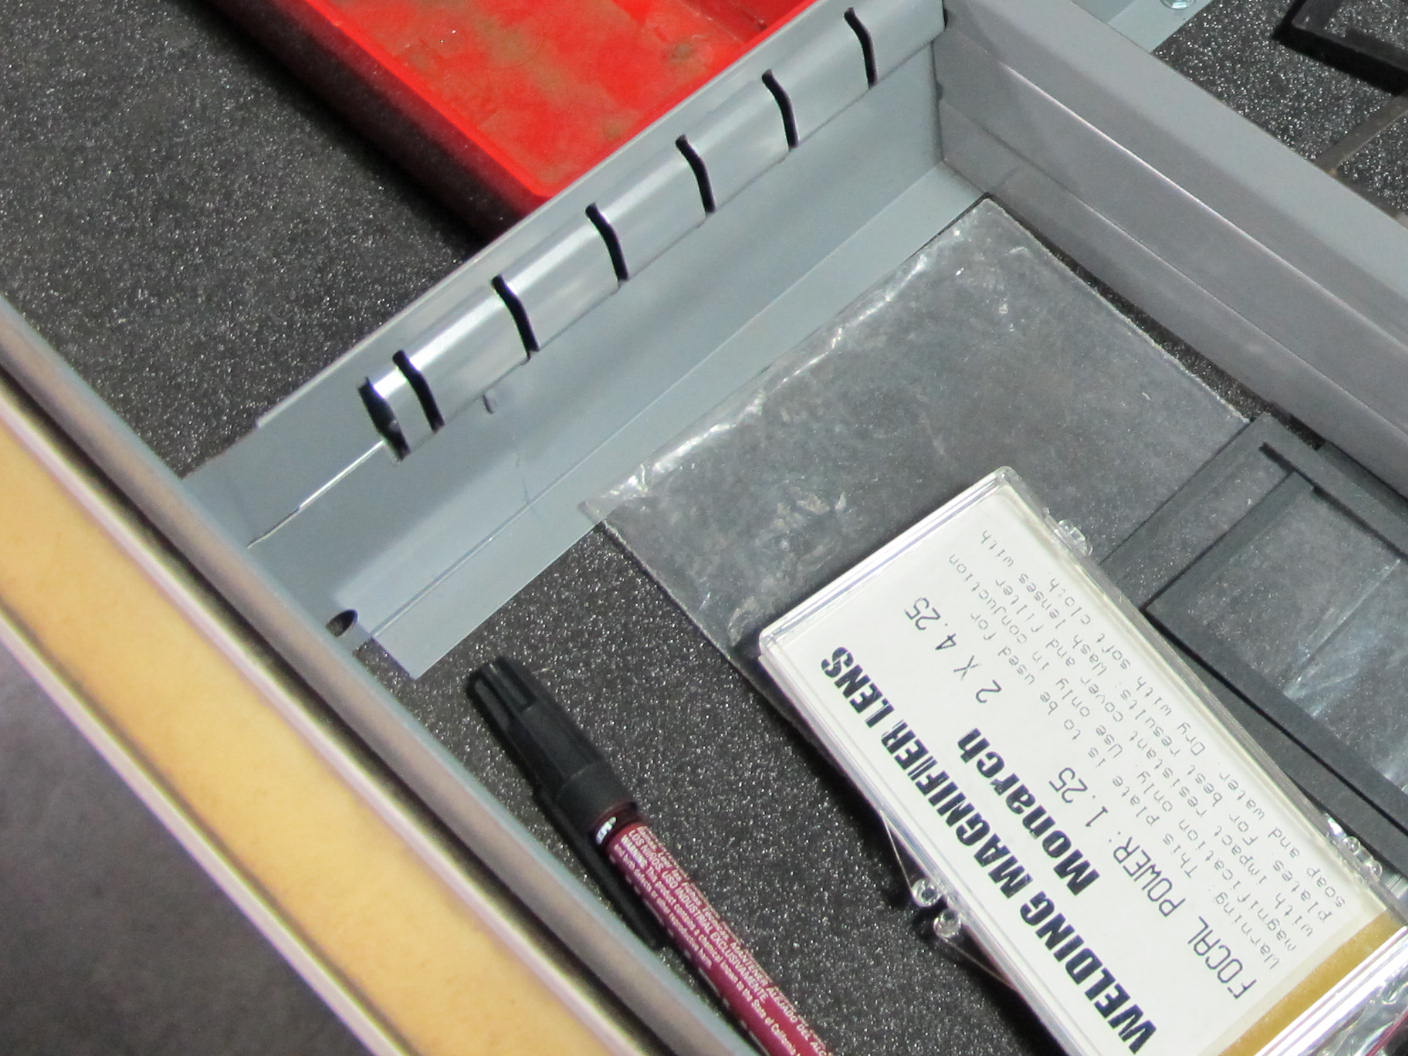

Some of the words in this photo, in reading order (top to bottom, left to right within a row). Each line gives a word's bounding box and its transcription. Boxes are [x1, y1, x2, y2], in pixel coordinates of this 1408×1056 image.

[978, 529, 1015, 568] with
[946, 553, 1028, 644] conjuction
[993, 578, 1044, 633] filter
[1017, 572, 1067, 629] lenses
[903, 597, 958, 653] 4.25
[968, 611, 997, 641] for
[952, 654, 979, 679] X
[996, 645, 1036, 686] used
[1029, 649, 1050, 672] in
[1044, 637, 1076, 668] and
[1070, 633, 1108, 676] Wash
[1094, 632, 1132, 671] soft
[819, 646, 894, 728] LENS
[974, 679, 1002, 705] 2
[1037, 690, 1059, 715] be
[1053, 677, 1092, 719] only
[1079, 676, 1125, 723] cover
[1134, 675, 1173, 717] with
[1061, 718, 1082, 741] to
[1093, 724, 1124, 759] Use
[1175, 721, 1207, 756] Dry
[1085, 746, 1106, 768] is
[1127, 731, 1207, 817] resistant
[1048, 766, 1109, 828] 1.25
[1110, 775, 1160, 827] plate
[1185, 764, 1223, 807] best
[881, 723, 1031, 897] MAGNIFIER
[956, 729, 1098, 894] Monarch
[1227, 813, 1259, 846] For
[1160, 832, 1199, 878] This
[1212, 825, 1268, 885] impact
[1266, 826, 1301, 860] and
[1108, 833, 1185, 917] POWER:
[1176, 818, 1297, 952] magnification
[1305, 866, 1347, 909] soap
[1272, 892, 1314, 938] with
[1019, 892, 1156, 1052] WELDING
[1184, 916, 1256, 999] FOCAL
